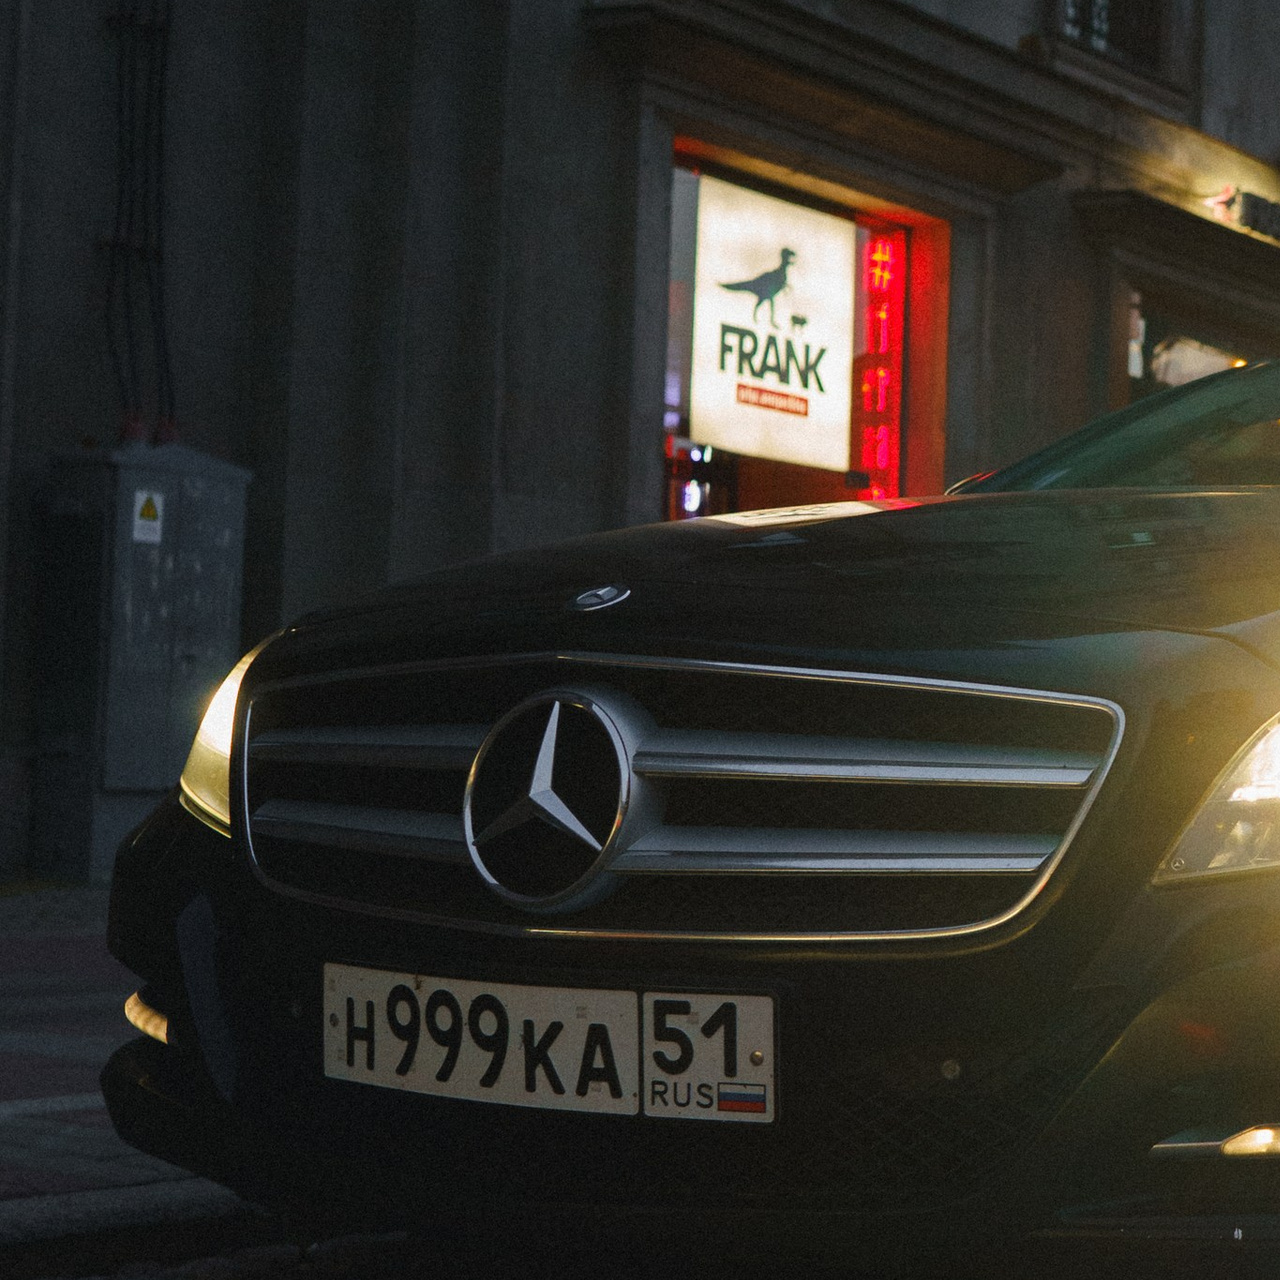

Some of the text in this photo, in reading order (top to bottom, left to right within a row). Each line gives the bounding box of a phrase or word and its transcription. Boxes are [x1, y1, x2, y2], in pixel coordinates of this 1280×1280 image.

[719, 323, 828, 393] FRANK
[652, 999, 737, 1078] 51
[650, 1081, 714, 1109] RUS
